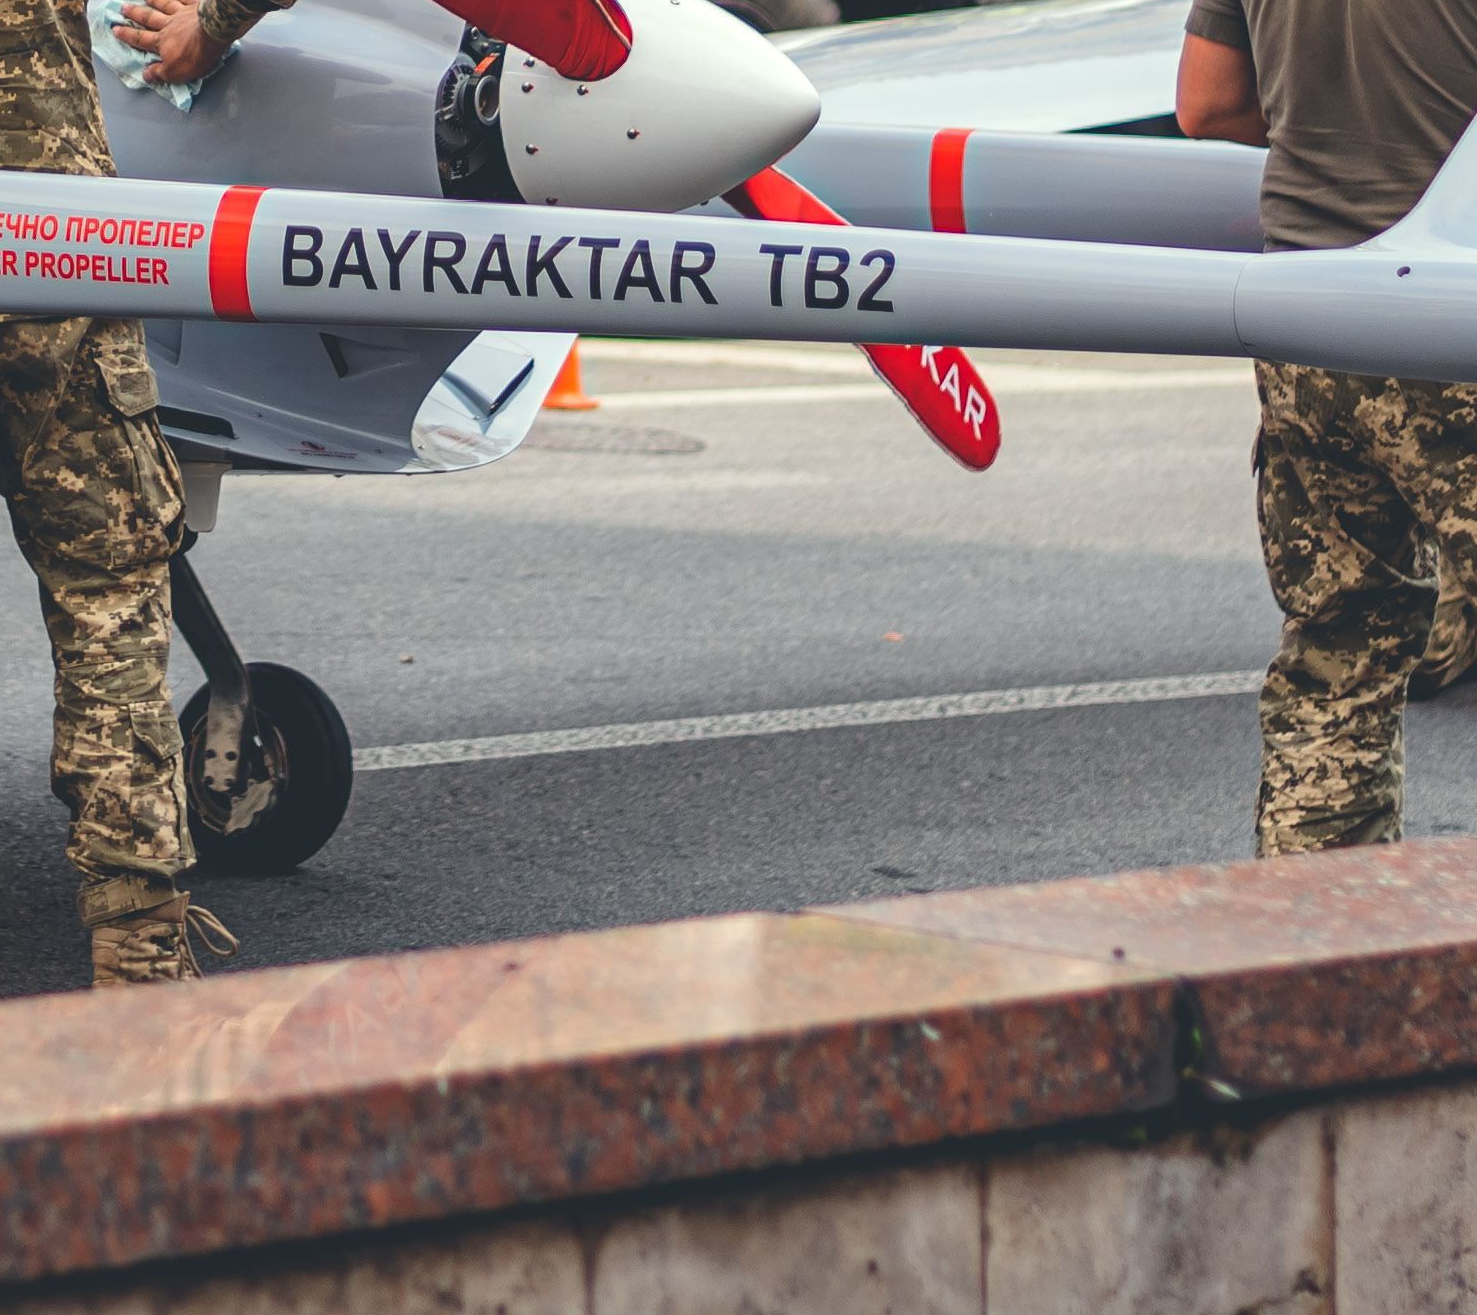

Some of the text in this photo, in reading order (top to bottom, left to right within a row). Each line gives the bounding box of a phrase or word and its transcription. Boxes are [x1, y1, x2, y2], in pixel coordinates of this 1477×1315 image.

[65, 215, 206, 249] ПРОПЕЛЕР
[24, 253, 170, 285] PROPELLER
[282, 224, 896, 313] BAYRAKTAR TB2
[909, 344, 987, 442] KAR
